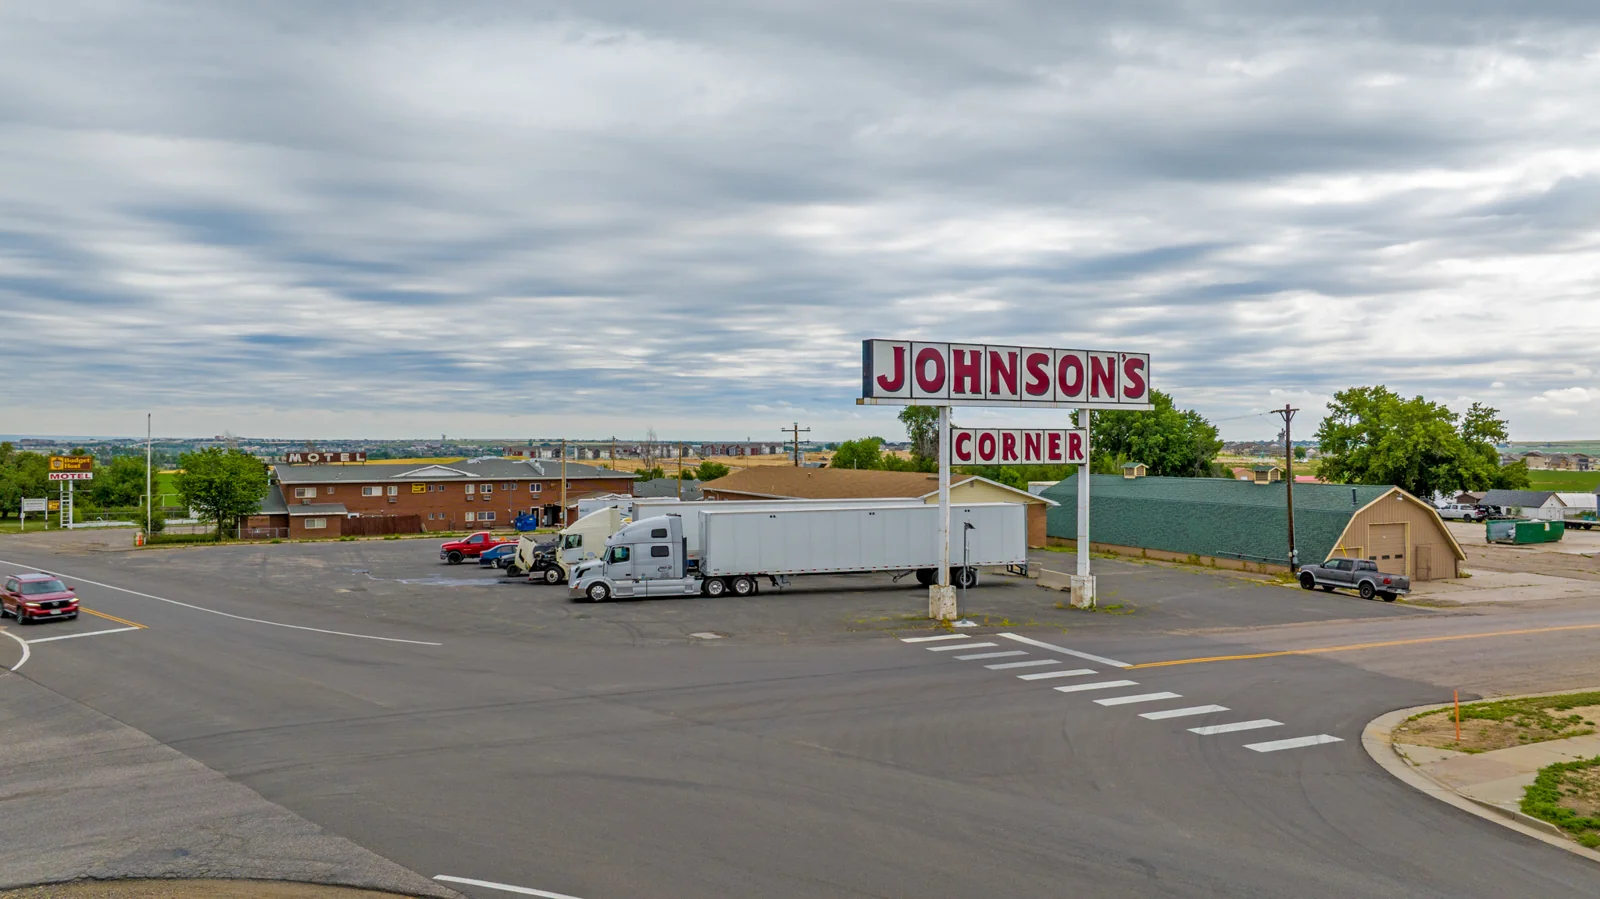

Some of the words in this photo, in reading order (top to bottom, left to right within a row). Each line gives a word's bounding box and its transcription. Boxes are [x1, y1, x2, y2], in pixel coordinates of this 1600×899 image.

[877, 346, 1145, 399] JOHNSON'S
[289, 453, 365, 462] MOTEL
[955, 432, 1084, 461] CORNER
